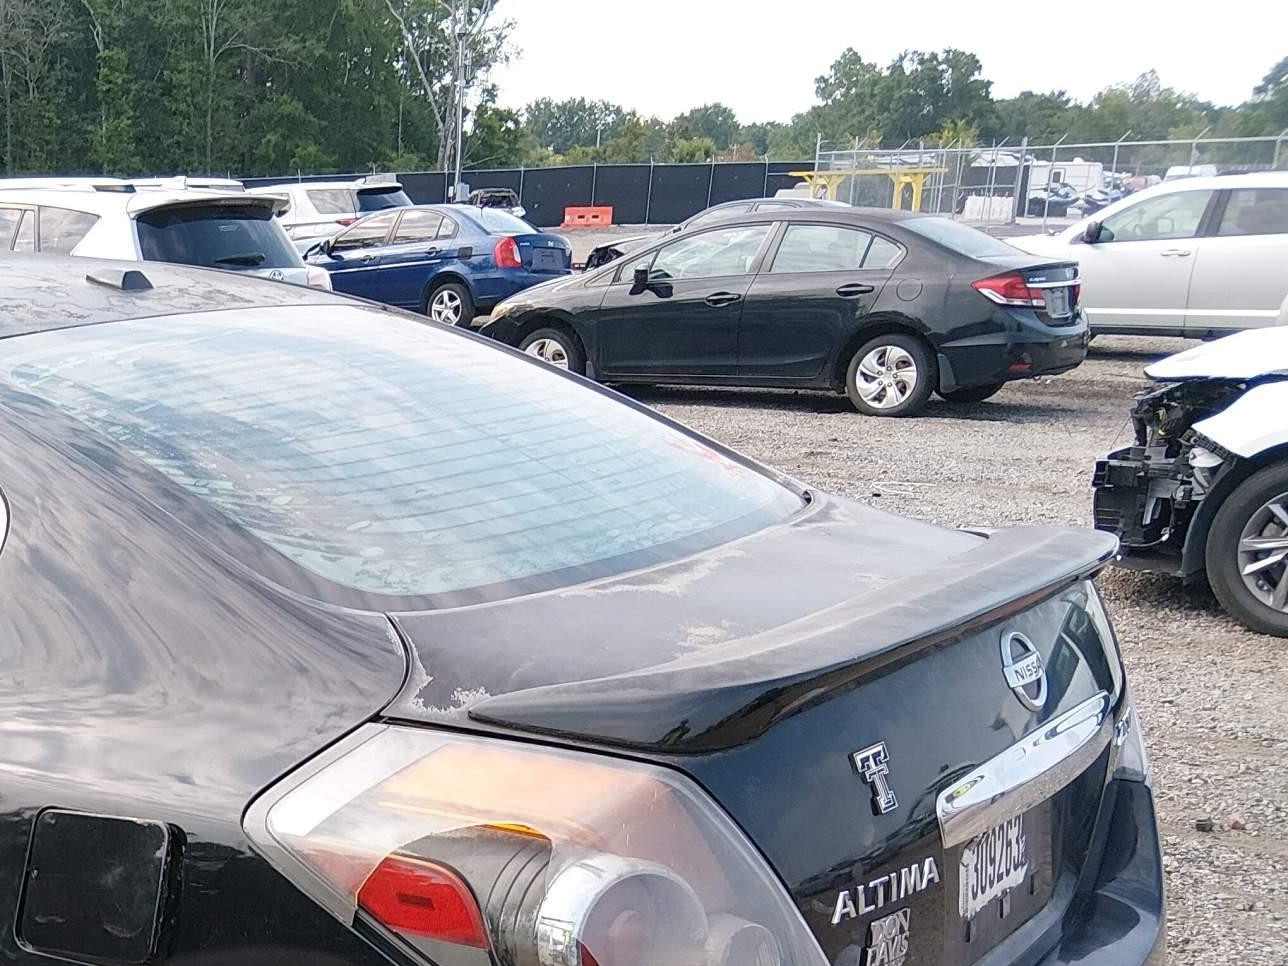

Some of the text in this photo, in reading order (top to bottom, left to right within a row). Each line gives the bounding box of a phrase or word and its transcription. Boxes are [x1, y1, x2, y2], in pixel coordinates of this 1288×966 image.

[1014, 654, 1043, 682] NISSA
[831, 857, 940, 925] ALTIMA
[870, 908, 911, 947] DON
